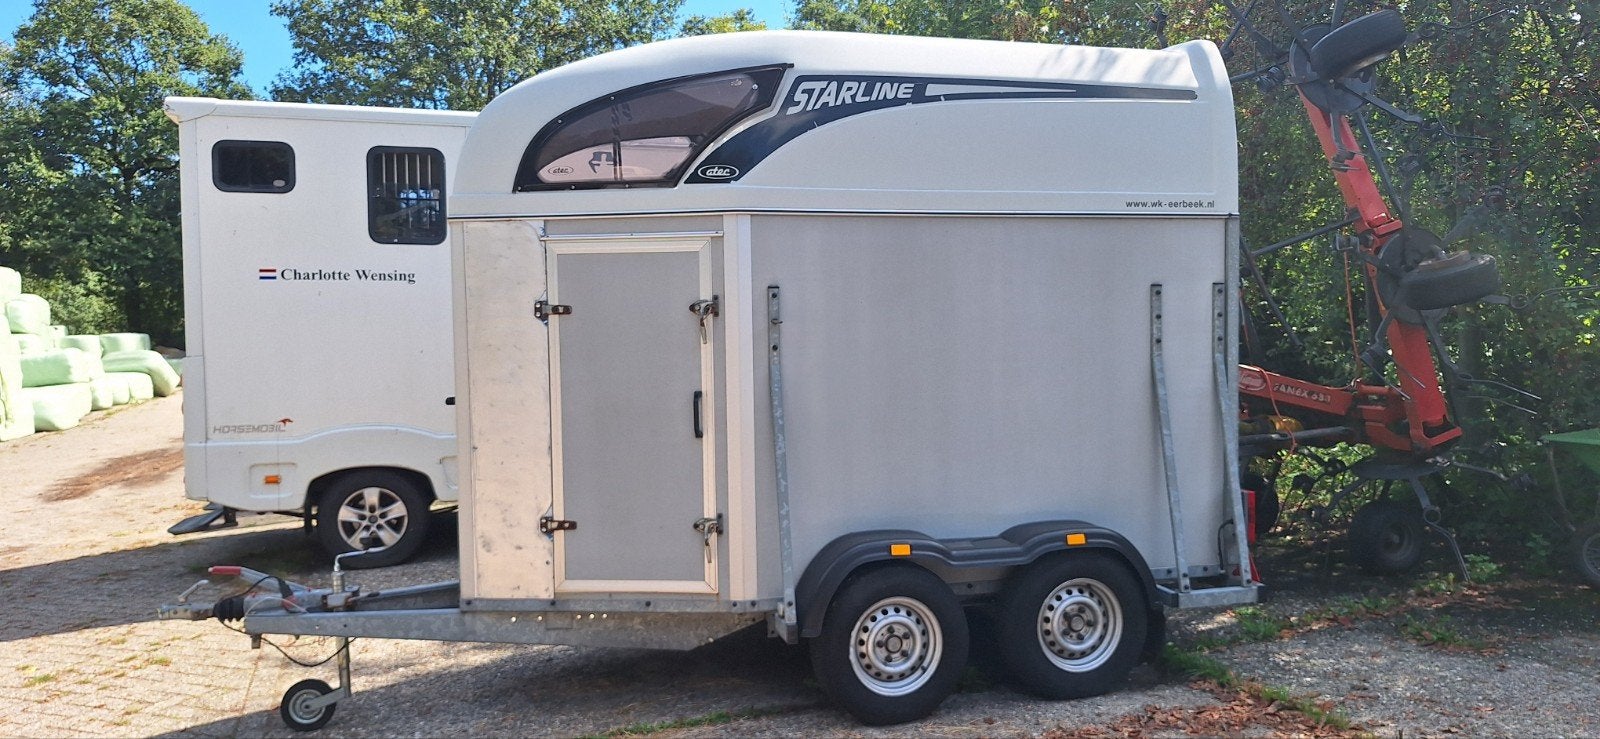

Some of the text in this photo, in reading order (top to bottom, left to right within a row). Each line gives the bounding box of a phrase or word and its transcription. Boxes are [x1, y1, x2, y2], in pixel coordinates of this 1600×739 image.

[786, 80, 914, 115] STARLINE
[706, 166, 731, 177] atec
[1125, 200, 1215, 209] www.wk-eerbeek.nl
[280, 268, 416, 285] Charlotte Wensing
[213, 424, 286, 434] HORSEMOBIL
